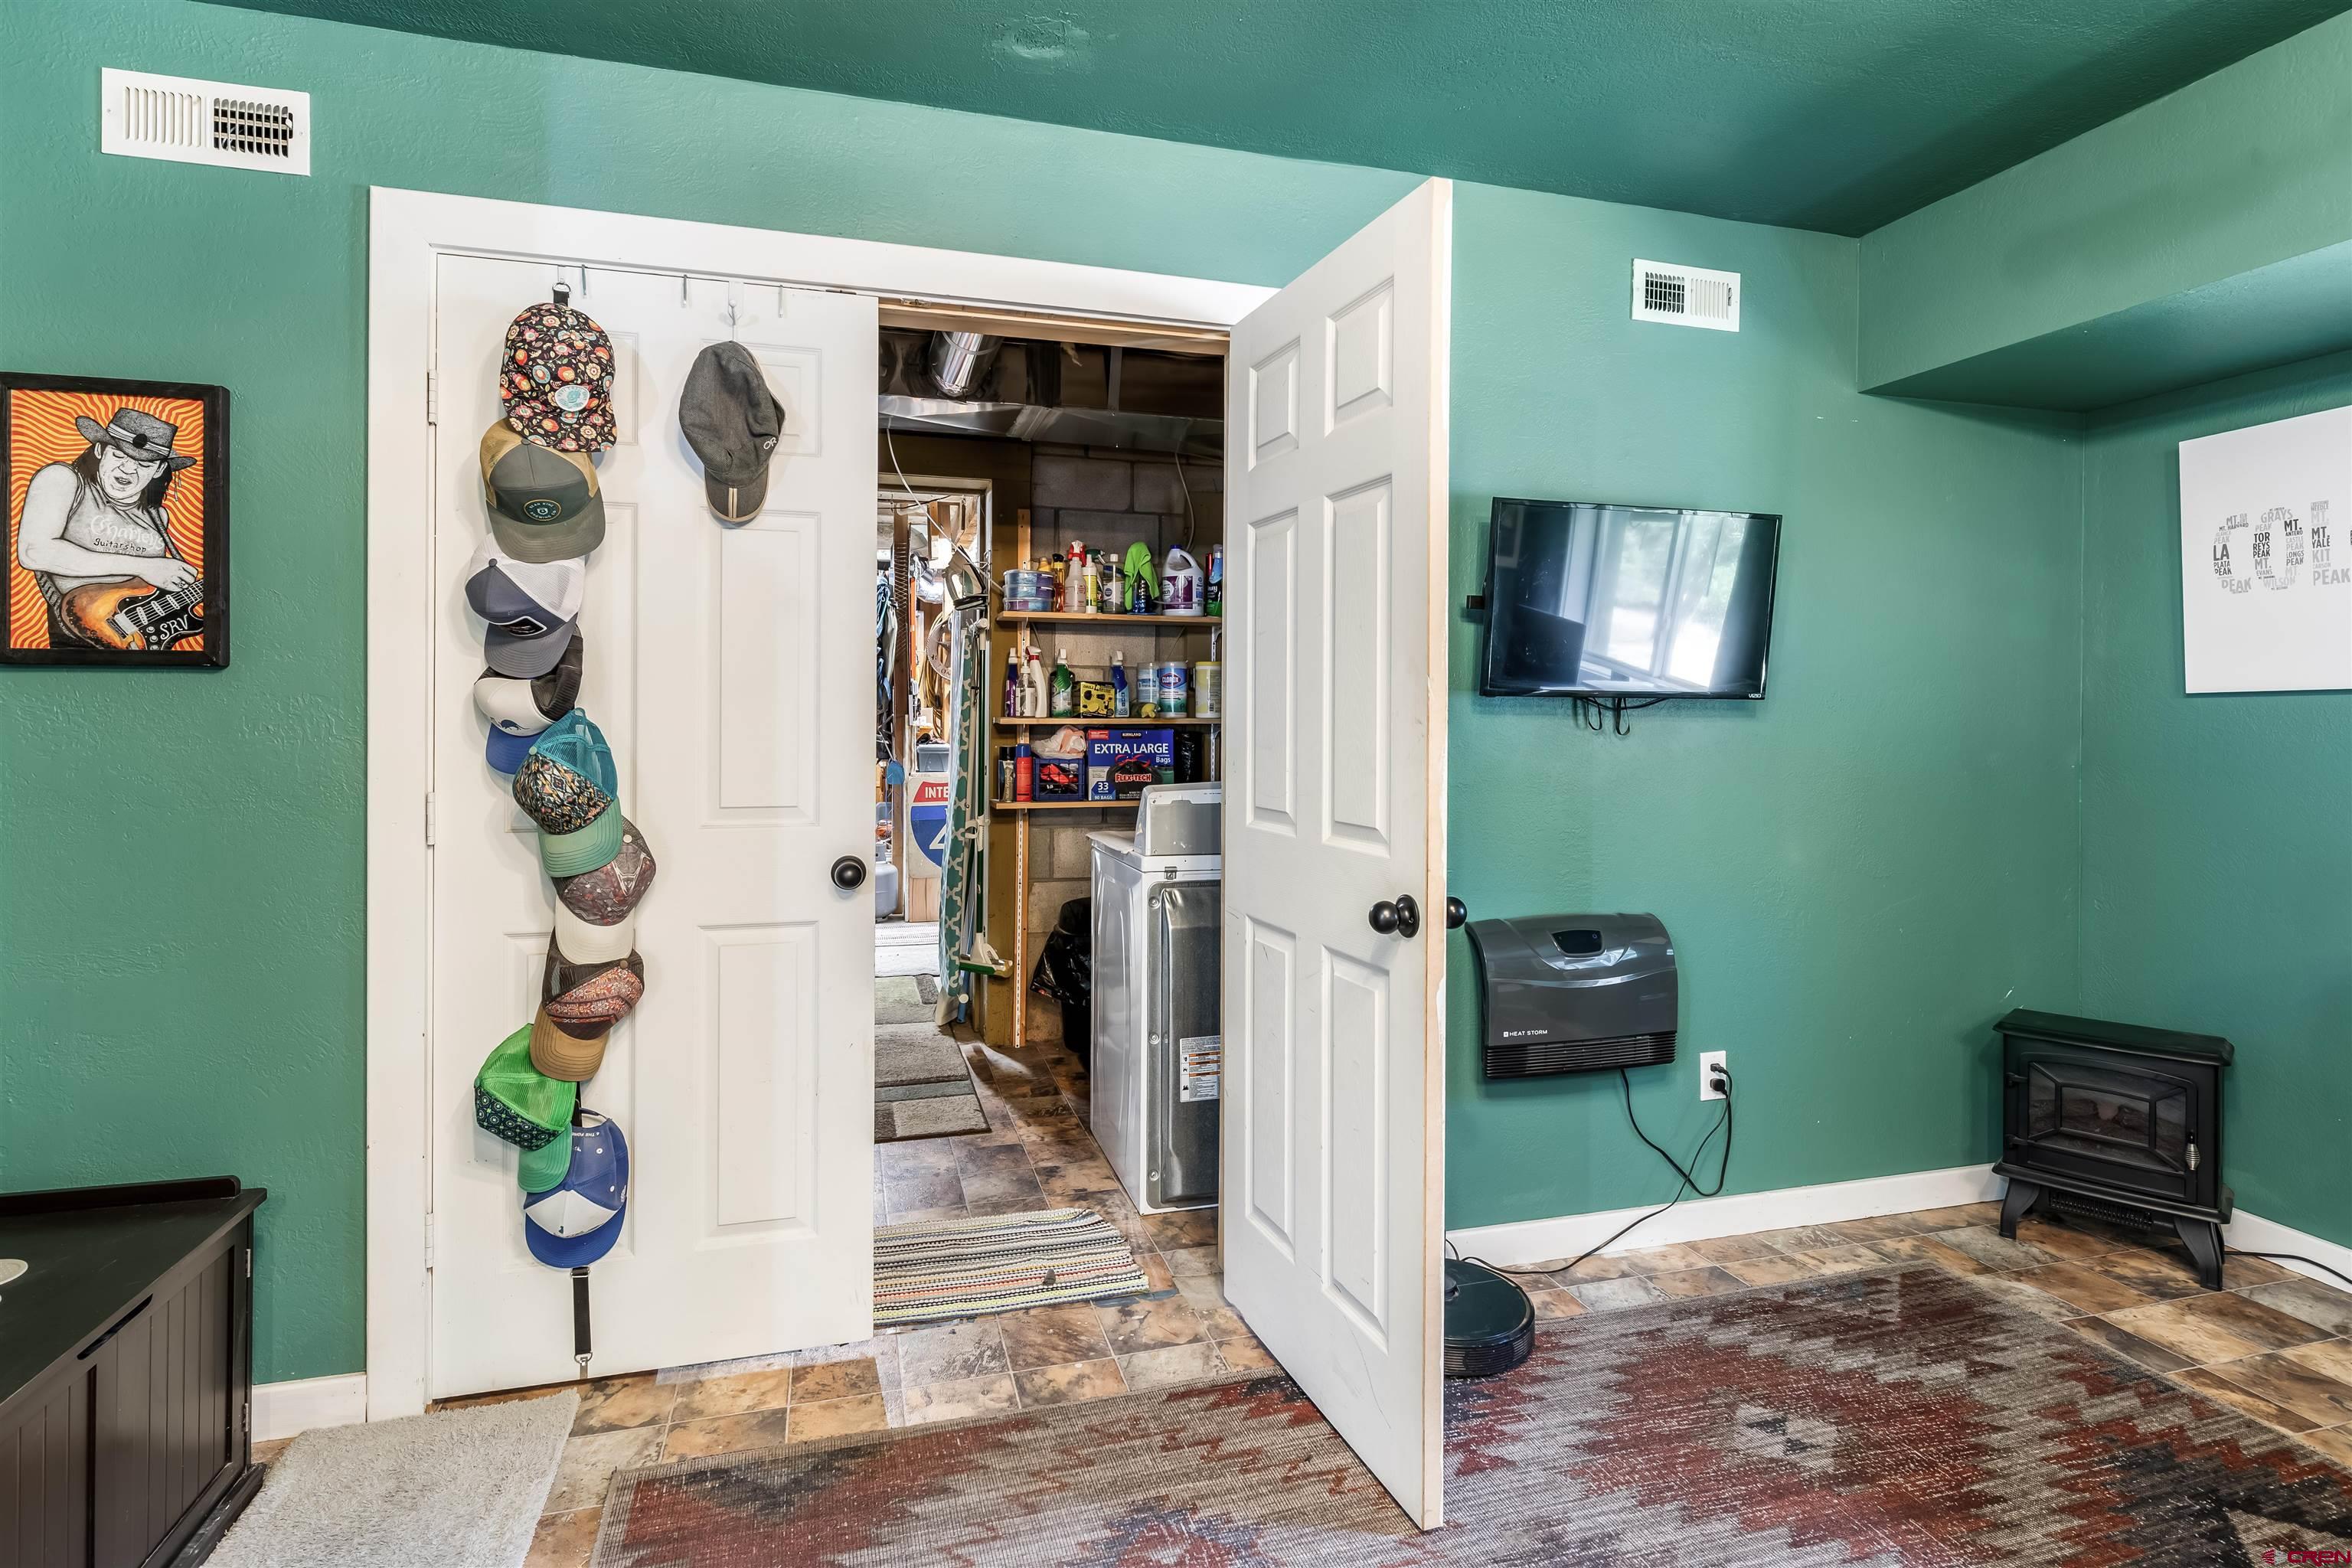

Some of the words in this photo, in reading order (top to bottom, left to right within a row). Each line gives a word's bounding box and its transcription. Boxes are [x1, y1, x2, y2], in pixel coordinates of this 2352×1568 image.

[763, 437, 776, 449] OR
[2261, 508, 2293, 524] GRAYS
[2256, 523, 2272, 532] PEAK
[2285, 519, 2302, 531] MT.
[2253, 532, 2270, 543] TOR
[2311, 527, 2330, 540] MT.
[2252, 541, 2270, 551] REYS
[2287, 543, 2304, 551] PEAK
[2312, 537, 2330, 549] YALE
[2213, 544, 2230, 561] LA
[2252, 549, 2270, 558] PEAK
[2287, 550, 2305, 559] LONGS
[2312, 549, 2330, 563] KIT
[2255, 558, 2272, 570] MT.
[2287, 557, 2304, 566] PEAK
[2215, 567, 2232, 576] PEAK
[2313, 568, 2350, 586] PEAK
[2221, 577, 2252, 593] PEAK
[2263, 577, 2296, 589] WILSON
[160, 614, 188, 640] SRV
[1094, 743, 1131, 754] EXTRA
[1133, 743, 1169, 754] LARGE
[1115, 773, 1152, 782] FLEX-TECH
[925, 786, 949, 798] INTE
[1097, 782, 1109, 790] 33
